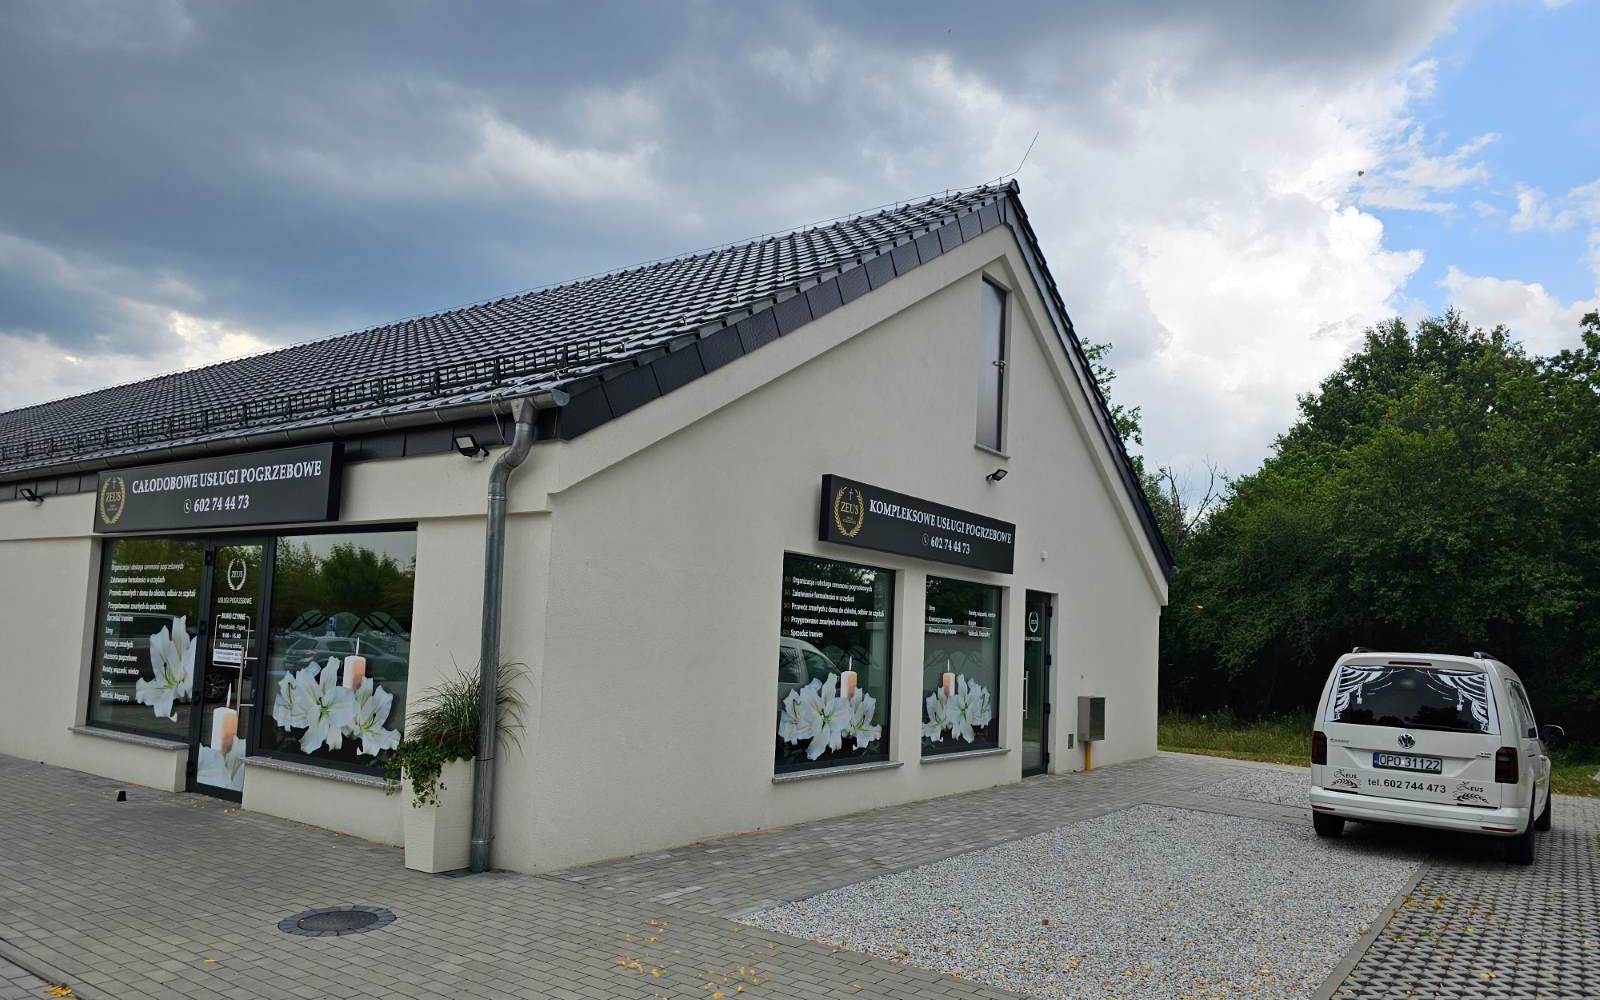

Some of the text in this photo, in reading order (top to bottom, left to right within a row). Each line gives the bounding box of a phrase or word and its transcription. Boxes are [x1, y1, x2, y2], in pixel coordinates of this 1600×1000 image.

[132, 460, 322, 494] CAŁODOBOWE USŁUGI POGRZEBOWE
[106, 492, 122, 502] ZEUS
[194, 494, 250, 512] 602 74 44 73
[840, 501, 860, 514] ZEUS
[869, 499, 936, 527] KOMPLEKSOWE
[936, 516, 965, 532] USŁUGI
[965, 523, 1012, 544] POGRZEBOWE
[930, 536, 970, 554] 602 74 44 73
[1380, 754, 1440, 771] OPO 31122
[1368, 778, 1446, 793] tel. 602 744 473
